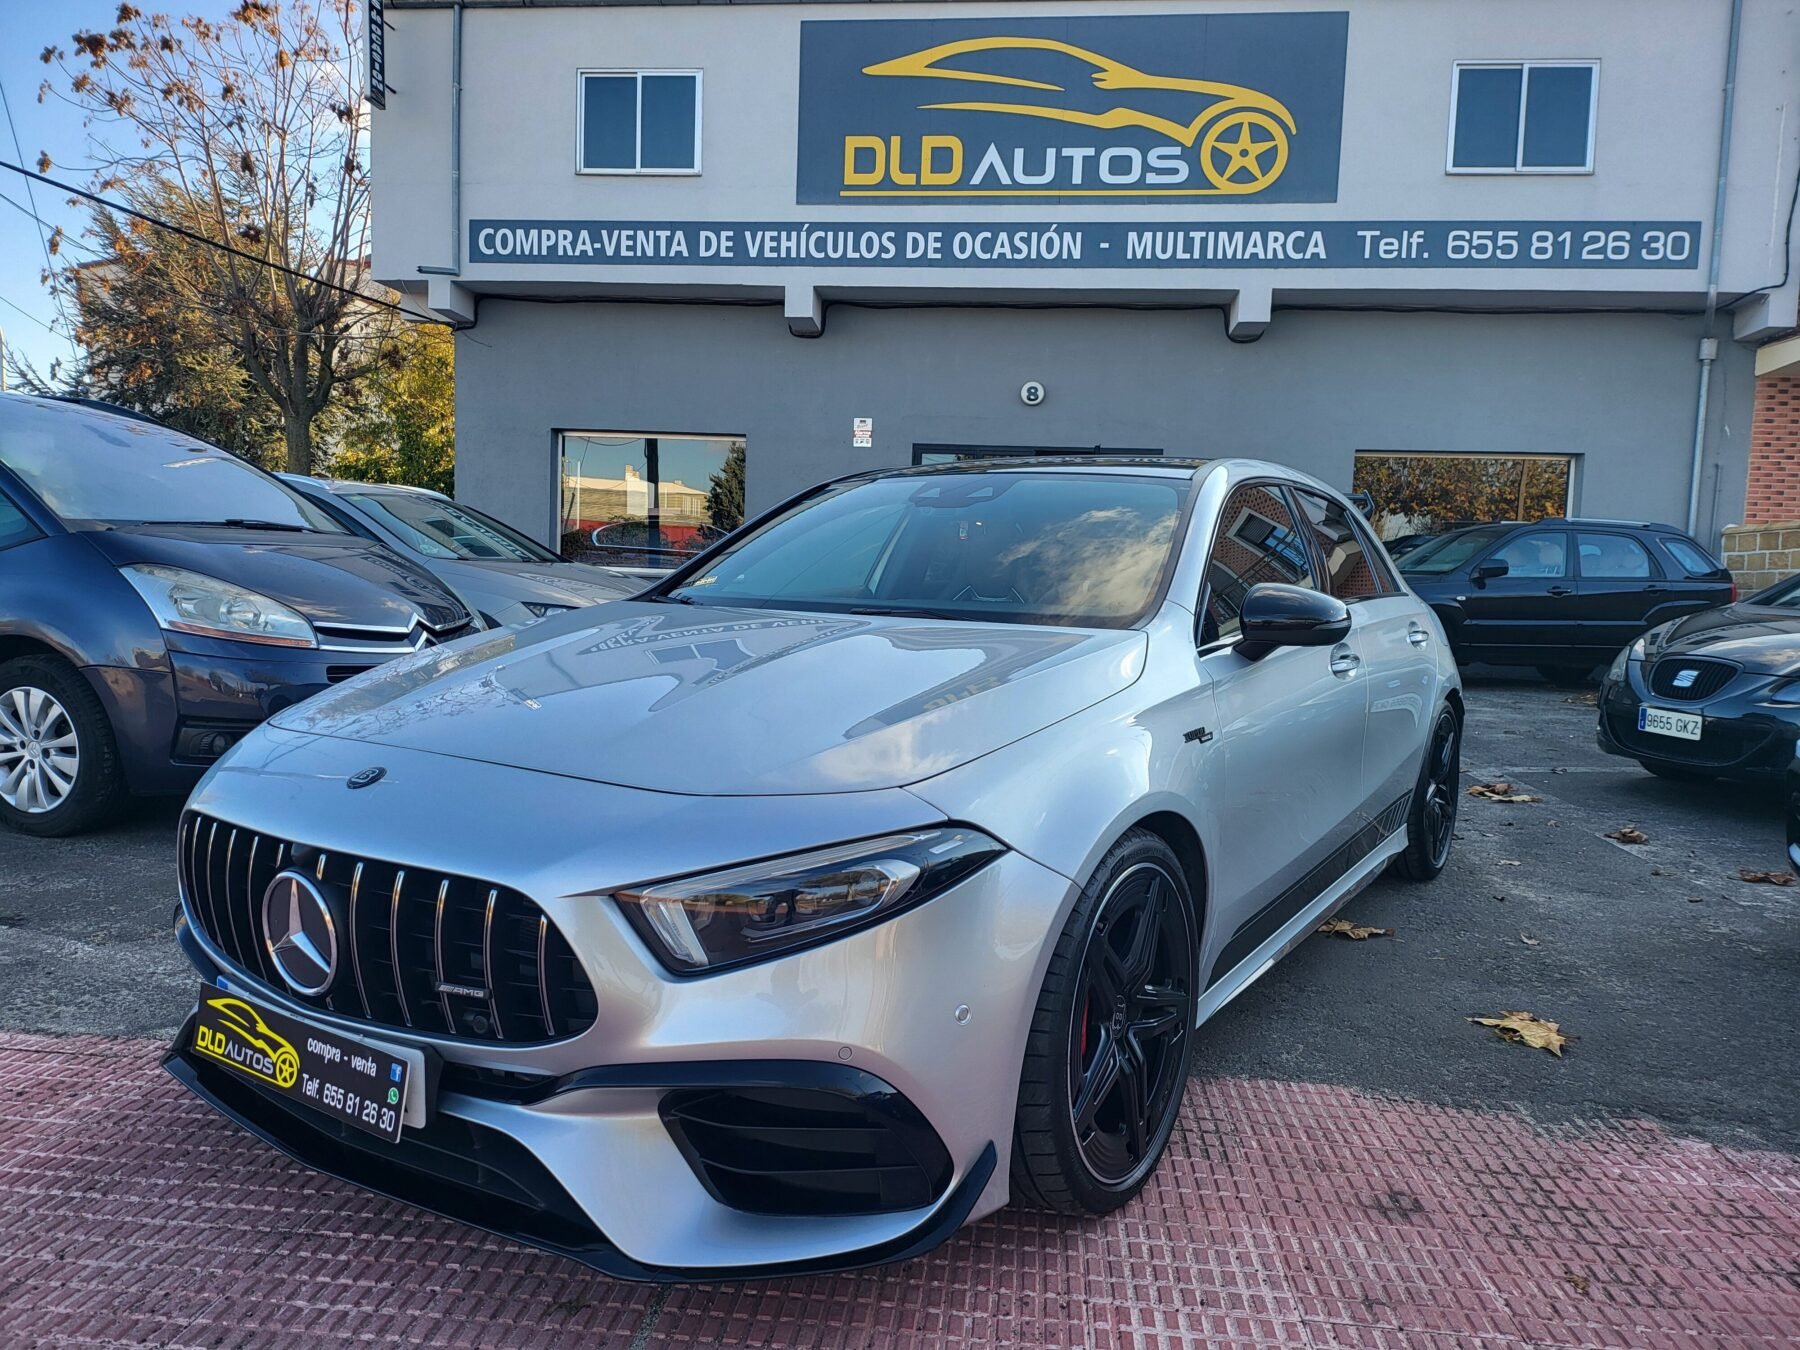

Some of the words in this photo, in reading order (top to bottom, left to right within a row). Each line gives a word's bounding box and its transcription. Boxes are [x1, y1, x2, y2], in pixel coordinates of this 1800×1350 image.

[844, 135, 963, 185] DLD
[969, 142, 1190, 185] AUTOS
[478, 228, 689, 258] COMPRA-VENTA
[699, 231, 734, 258] DE
[744, 223, 897, 259] VEHÍCULOS
[906, 231, 942, 259] DE
[952, 223, 1082, 260] OCASIÓN
[1126, 231, 1327, 260] MULTIMARCA
[1357, 230, 1429, 259] Telf.
[1447, 230, 1519, 260] 655
[1530, 231, 1571, 260] 81
[1582, 231, 1631, 260] 26
[1641, 231, 1690, 260] 30
[1026, 386, 1039, 401] 8
[1646, 713, 1672, 731] 9655
[1675, 718, 1699, 736] GKZ
[197, 1025, 226, 1055] DLD
[224, 1040, 274, 1075] AUTOS
[307, 1037, 341, 1064] compra
[351, 1054, 377, 1078] venta
[302, 1073, 320, 1100] Telf.
[323, 1083, 345, 1109] 655
[346, 1092, 360, 1117] 81
[362, 1100, 378, 1124] 26
[379, 1107, 396, 1132] 30
